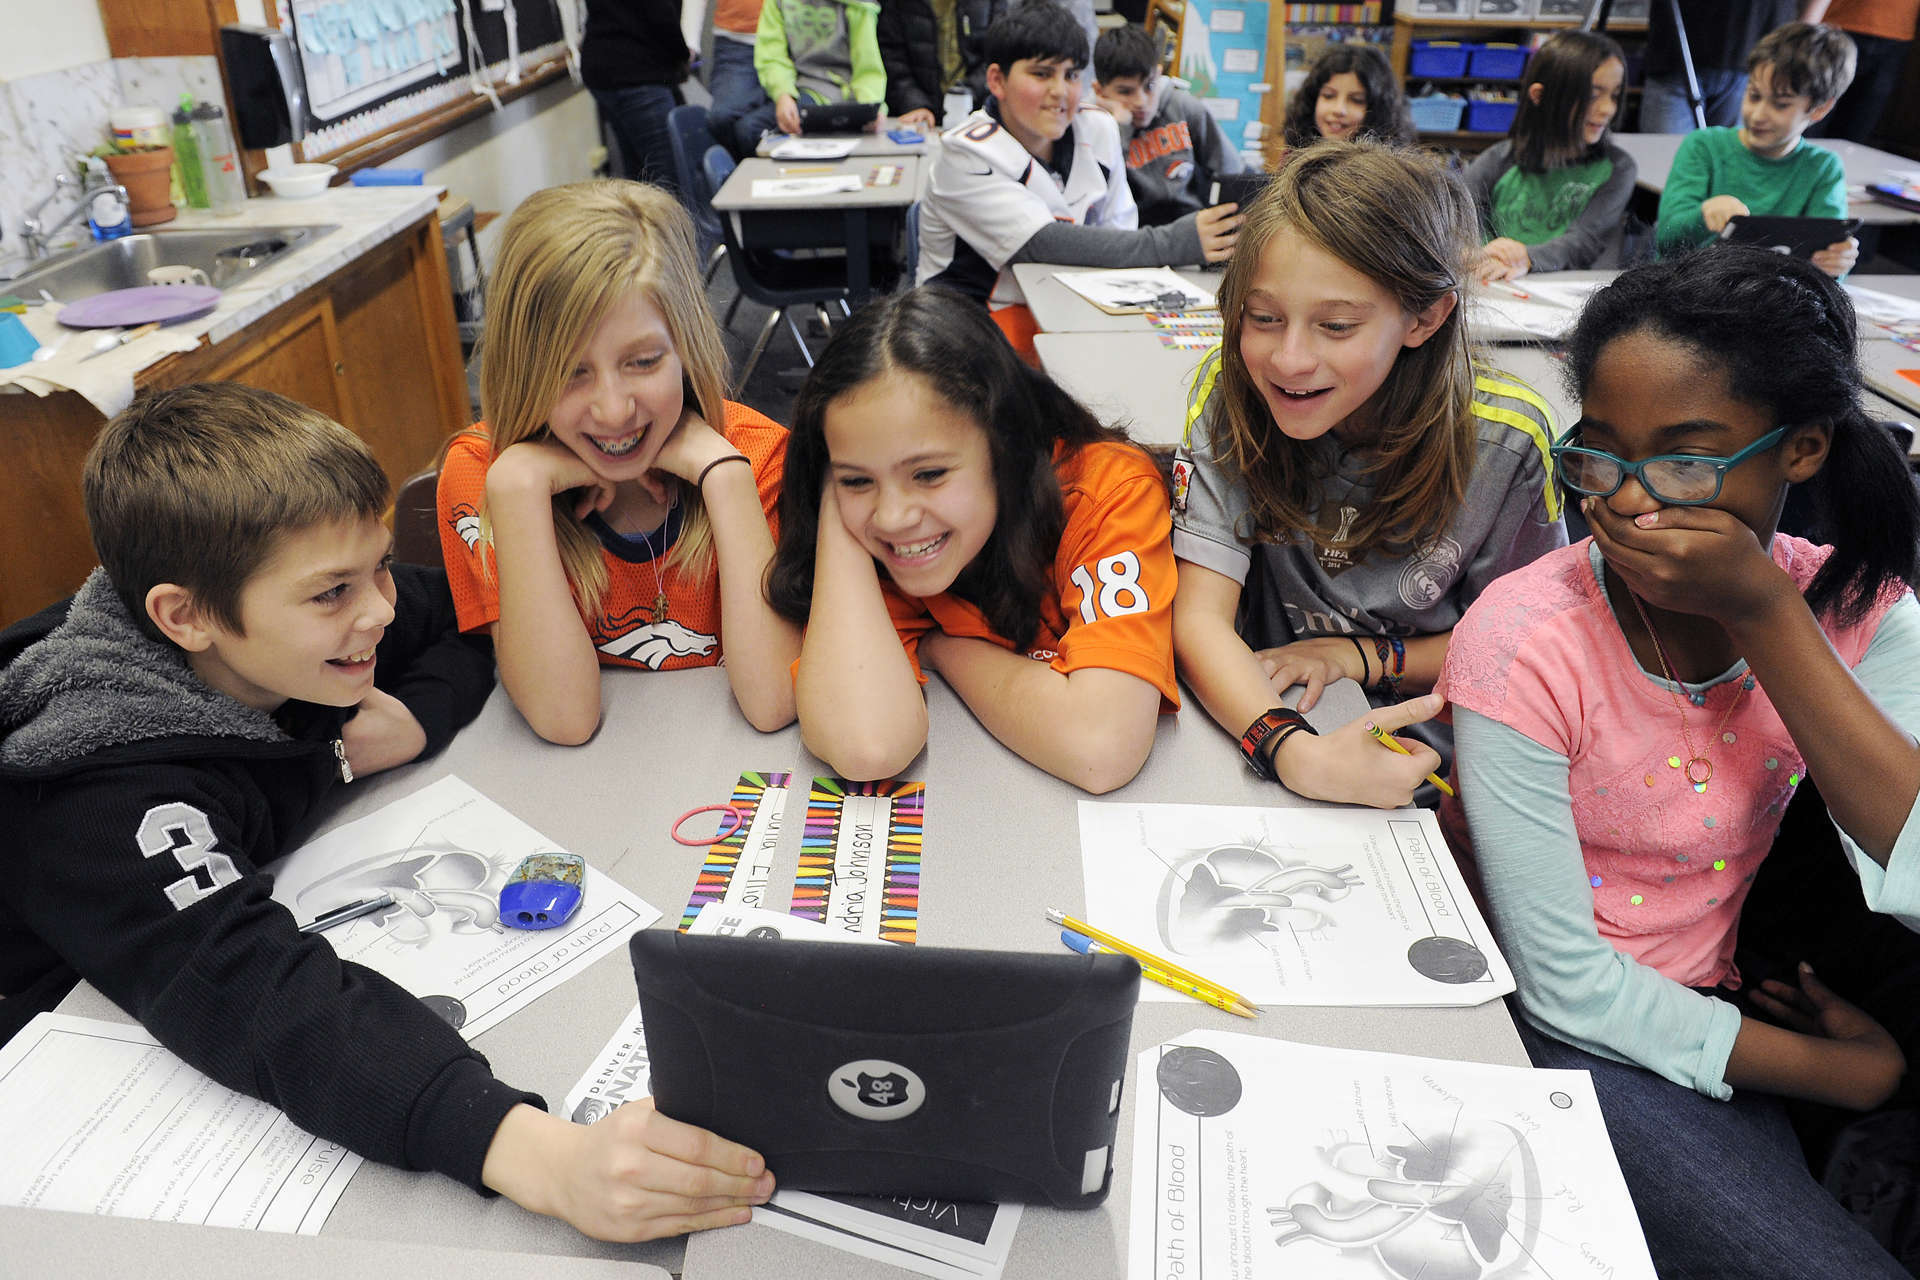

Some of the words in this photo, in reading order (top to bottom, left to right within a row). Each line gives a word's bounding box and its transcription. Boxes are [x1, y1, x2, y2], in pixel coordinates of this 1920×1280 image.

[1324, 548, 1348, 558] FIFA
[1070, 550, 1150, 625] 18
[135, 801, 244, 911] 3
[833, 823, 874, 887] Johnson
[1407, 837, 1425, 864] Path
[1426, 881, 1450, 917] Blood
[570, 920, 612, 950] Path
[496, 959, 548, 996] Blood
[588, 1040, 632, 1096] DENVER
[868, 1080, 895, 1104] 48
[1166, 1144, 1185, 1201] Blood
[1167, 1208, 1185, 1230] of
